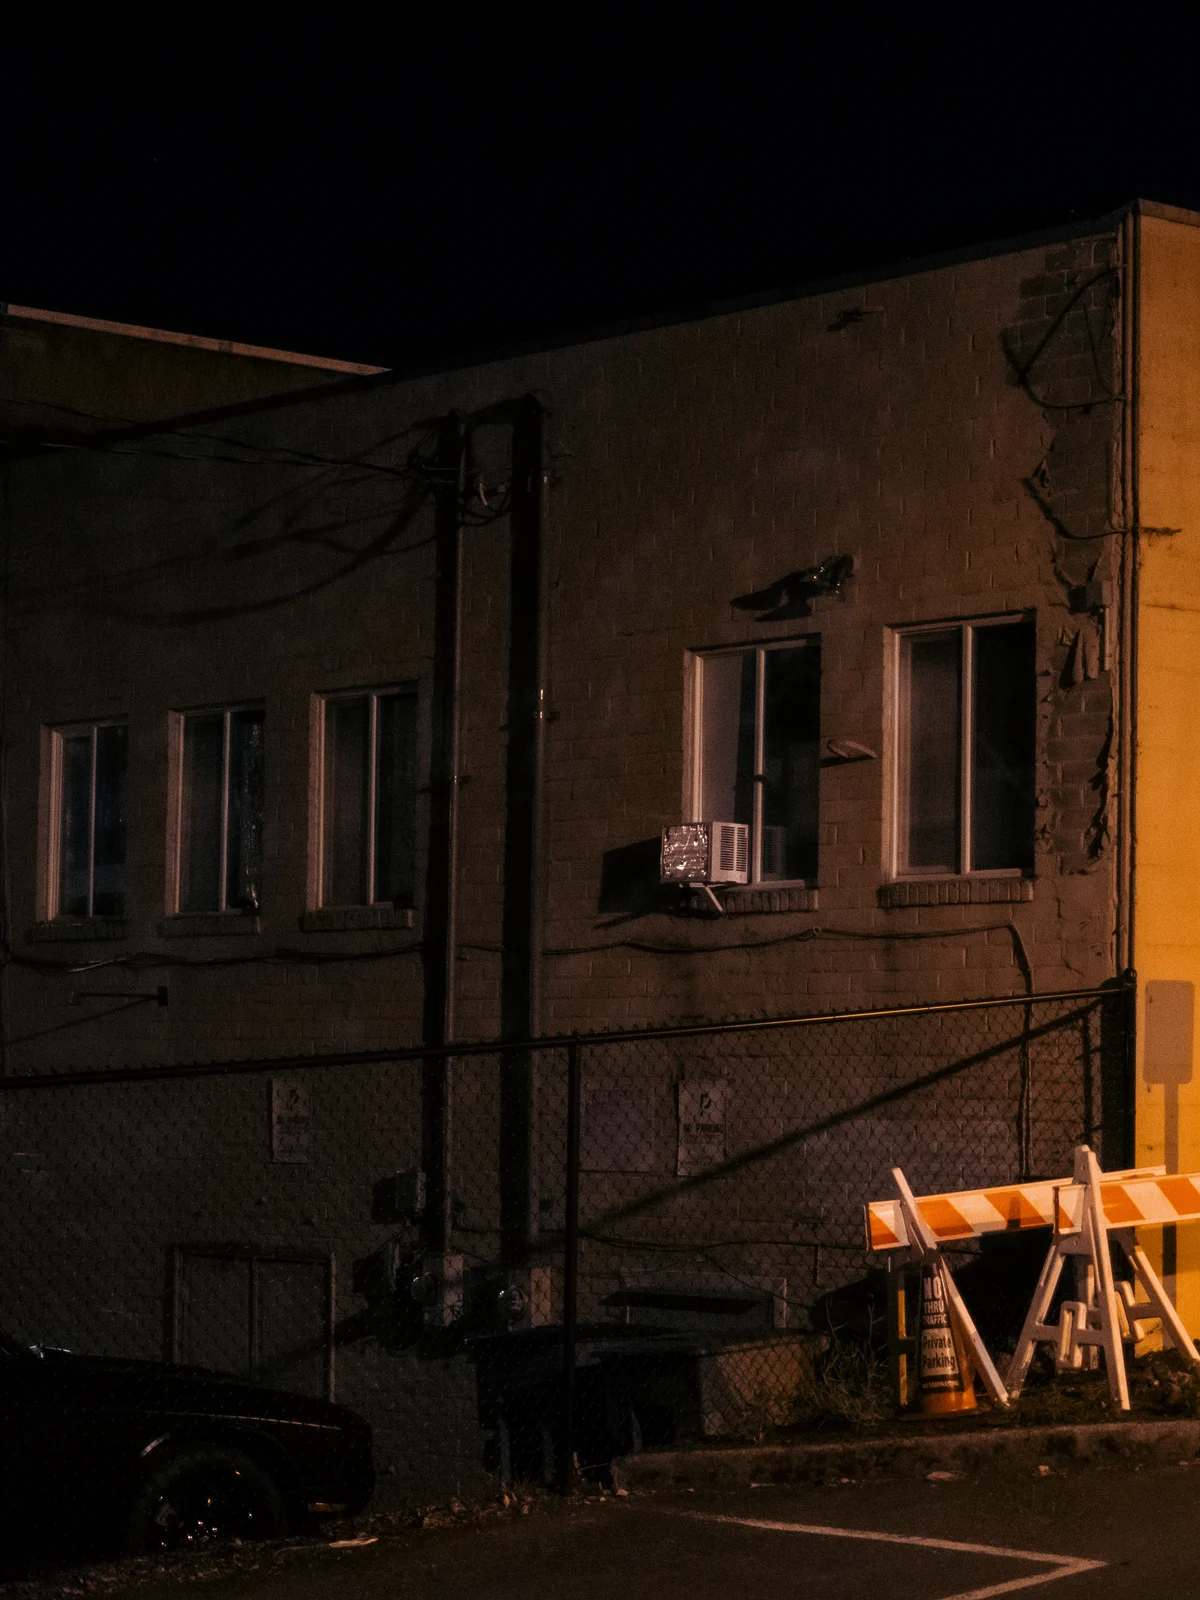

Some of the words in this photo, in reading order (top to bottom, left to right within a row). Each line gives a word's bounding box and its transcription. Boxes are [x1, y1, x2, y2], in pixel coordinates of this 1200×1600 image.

[923, 1276, 942, 1300] NO
[923, 1300, 945, 1315] THRU
[922, 1313, 948, 1326] TRAFFIC
[922, 1336, 952, 1349] Private
[922, 1352, 956, 1370] Parking
